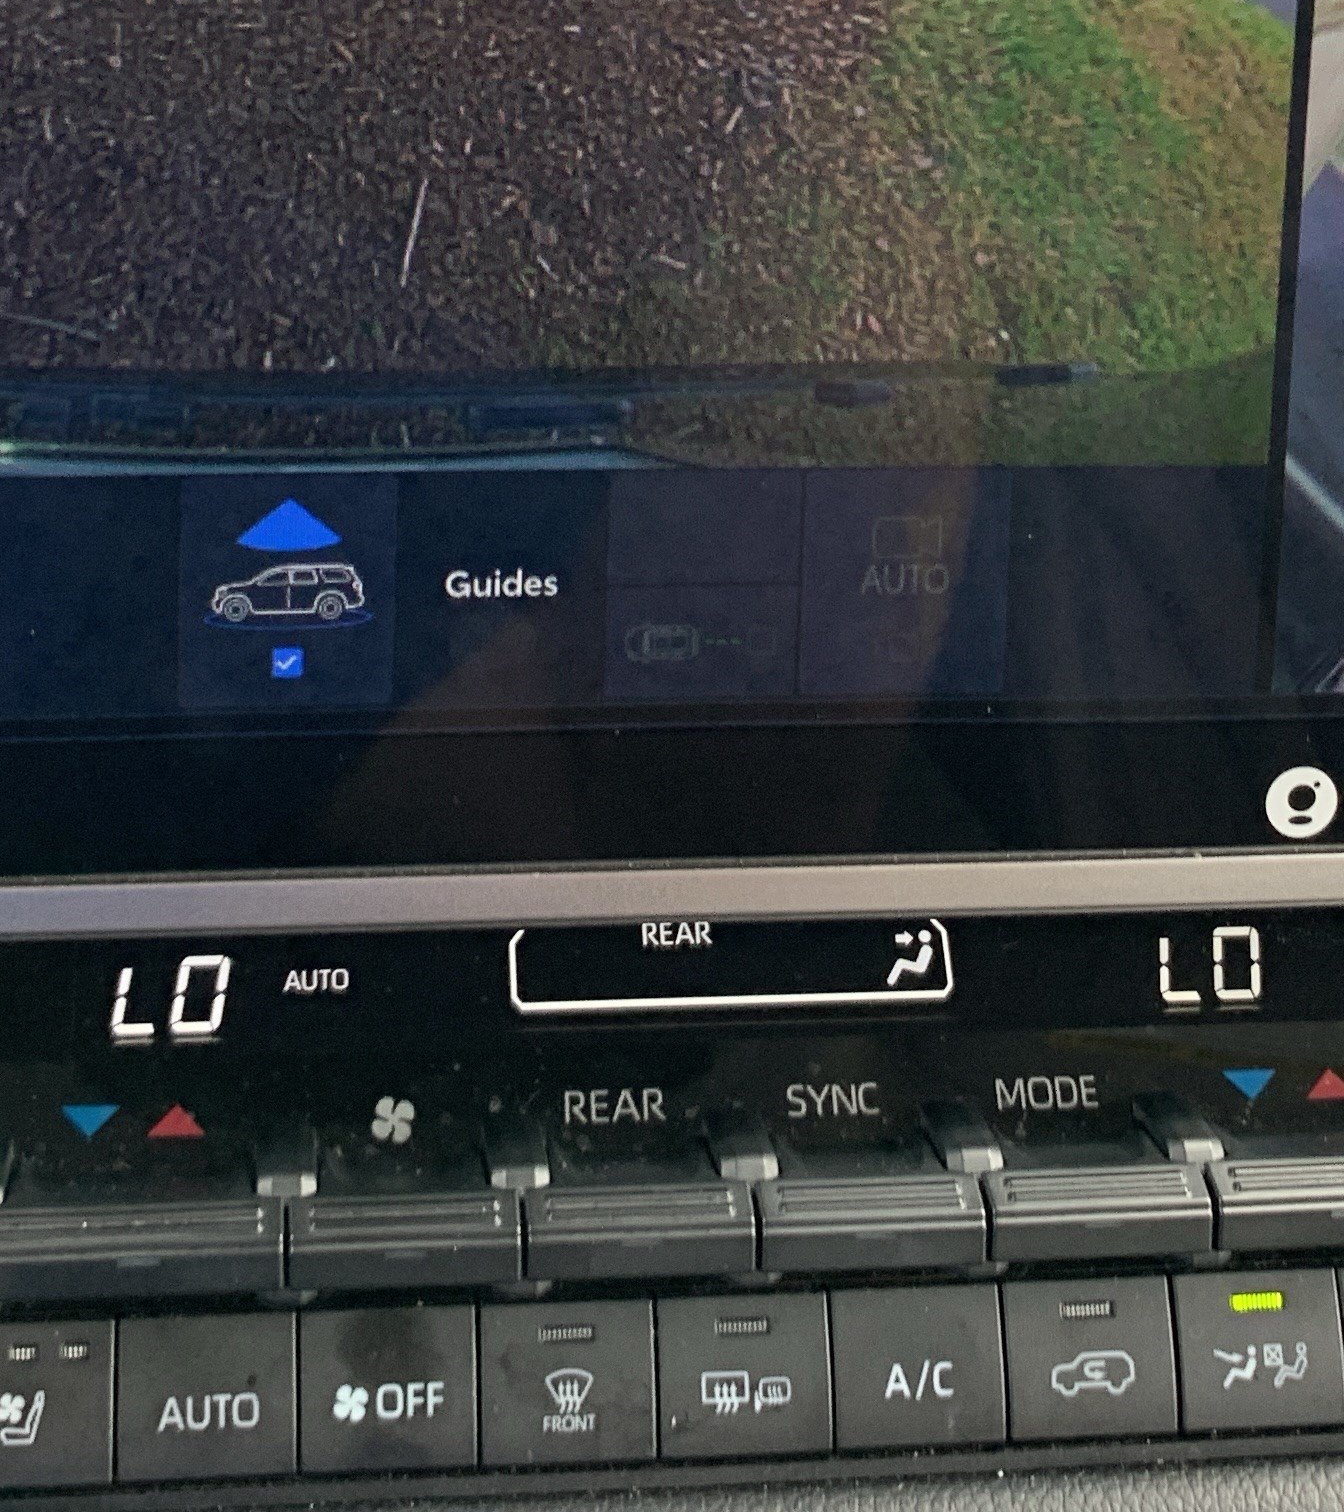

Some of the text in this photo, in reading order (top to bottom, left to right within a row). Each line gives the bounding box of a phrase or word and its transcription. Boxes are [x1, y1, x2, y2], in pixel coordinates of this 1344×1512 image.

[444, 568, 560, 599] Guides
[861, 565, 949, 595] AUTO
[640, 919, 714, 946] REAR
[283, 968, 351, 994] AUTO
[1158, 925, 1261, 1002] LO
[110, 954, 232, 1036] LO
[562, 1088, 667, 1125] REAR
[786, 1082, 881, 1118] SYNC
[994, 1074, 1100, 1112] MODE
[883, 1360, 955, 1400] A/C
[157, 1391, 260, 1434] AUTO
[374, 1381, 446, 1420] OFF
[541, 1413, 598, 1435] FRONT
